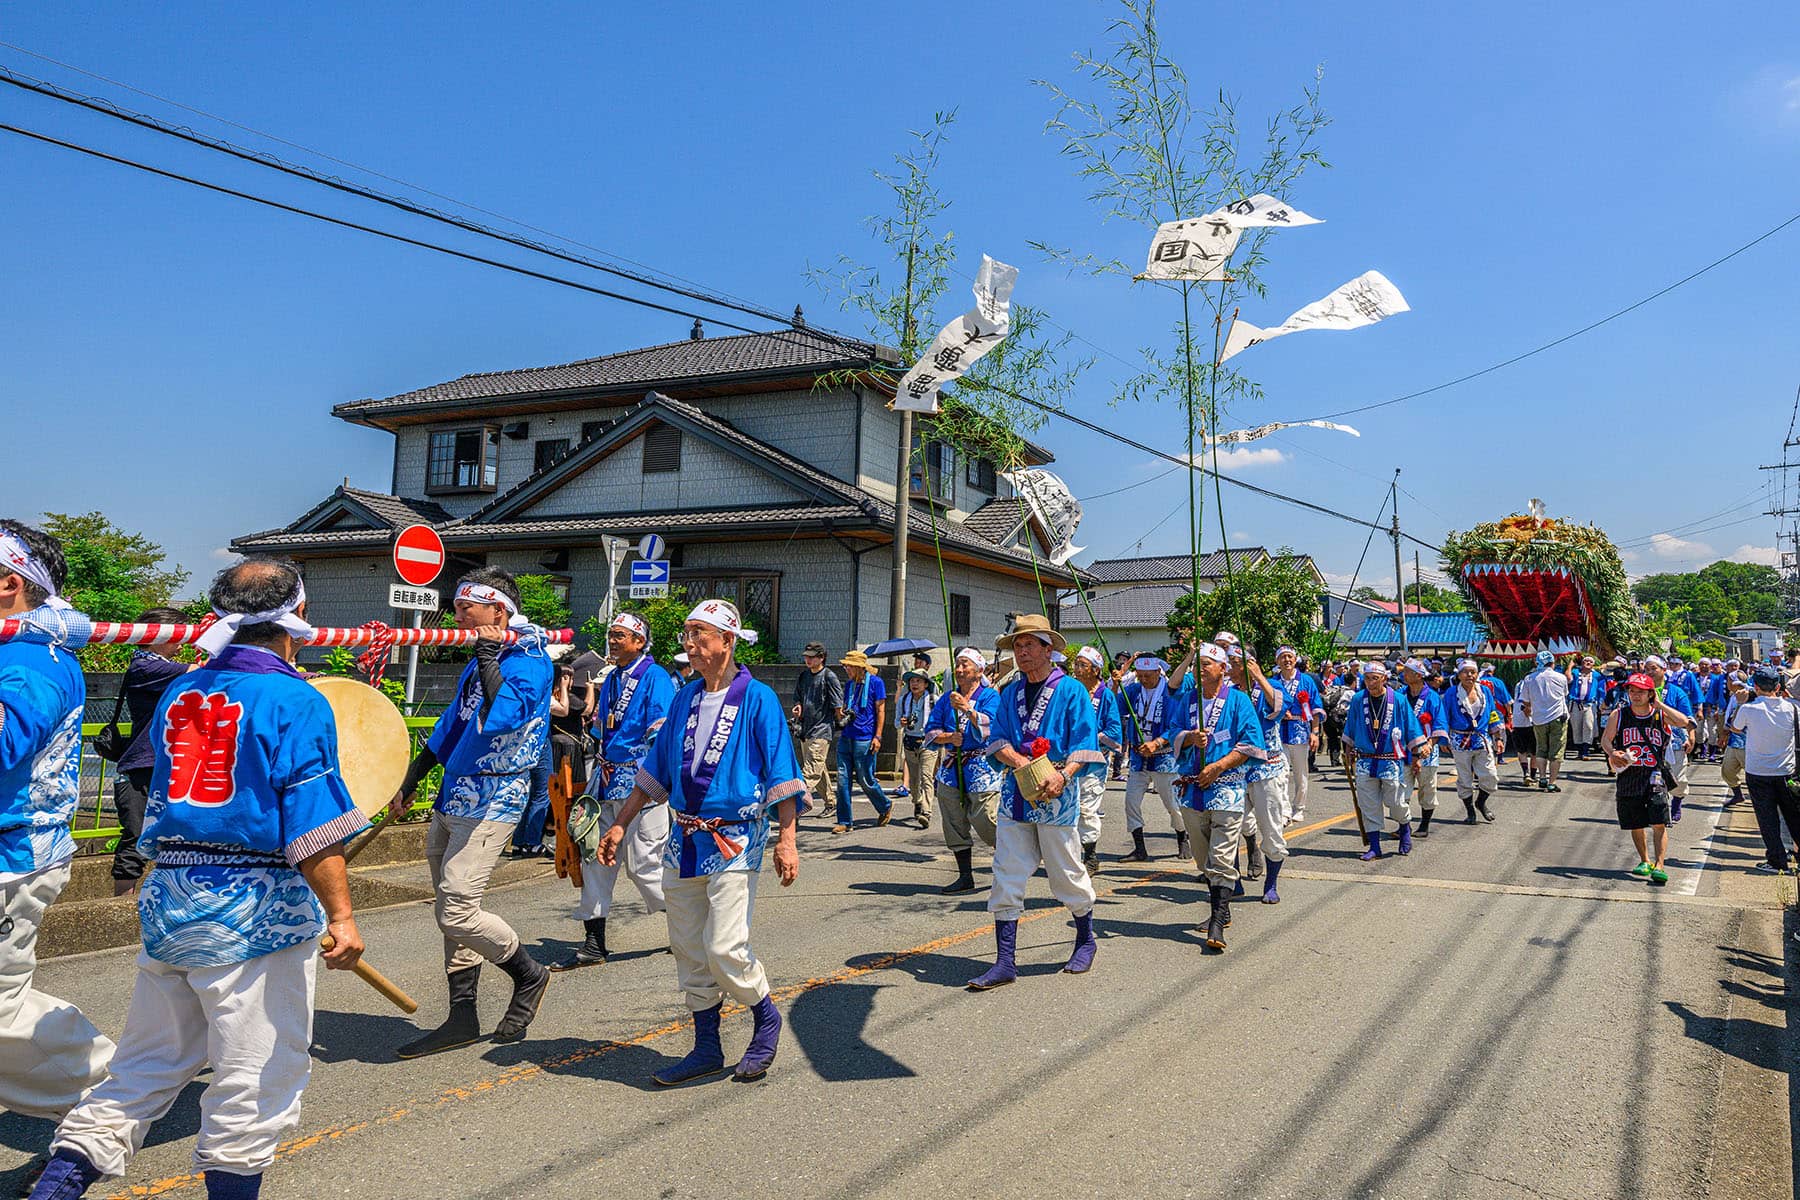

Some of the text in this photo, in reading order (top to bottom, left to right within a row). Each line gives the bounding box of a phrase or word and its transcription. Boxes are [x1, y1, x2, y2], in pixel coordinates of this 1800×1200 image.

[393, 589, 437, 607] 自転車を除く
